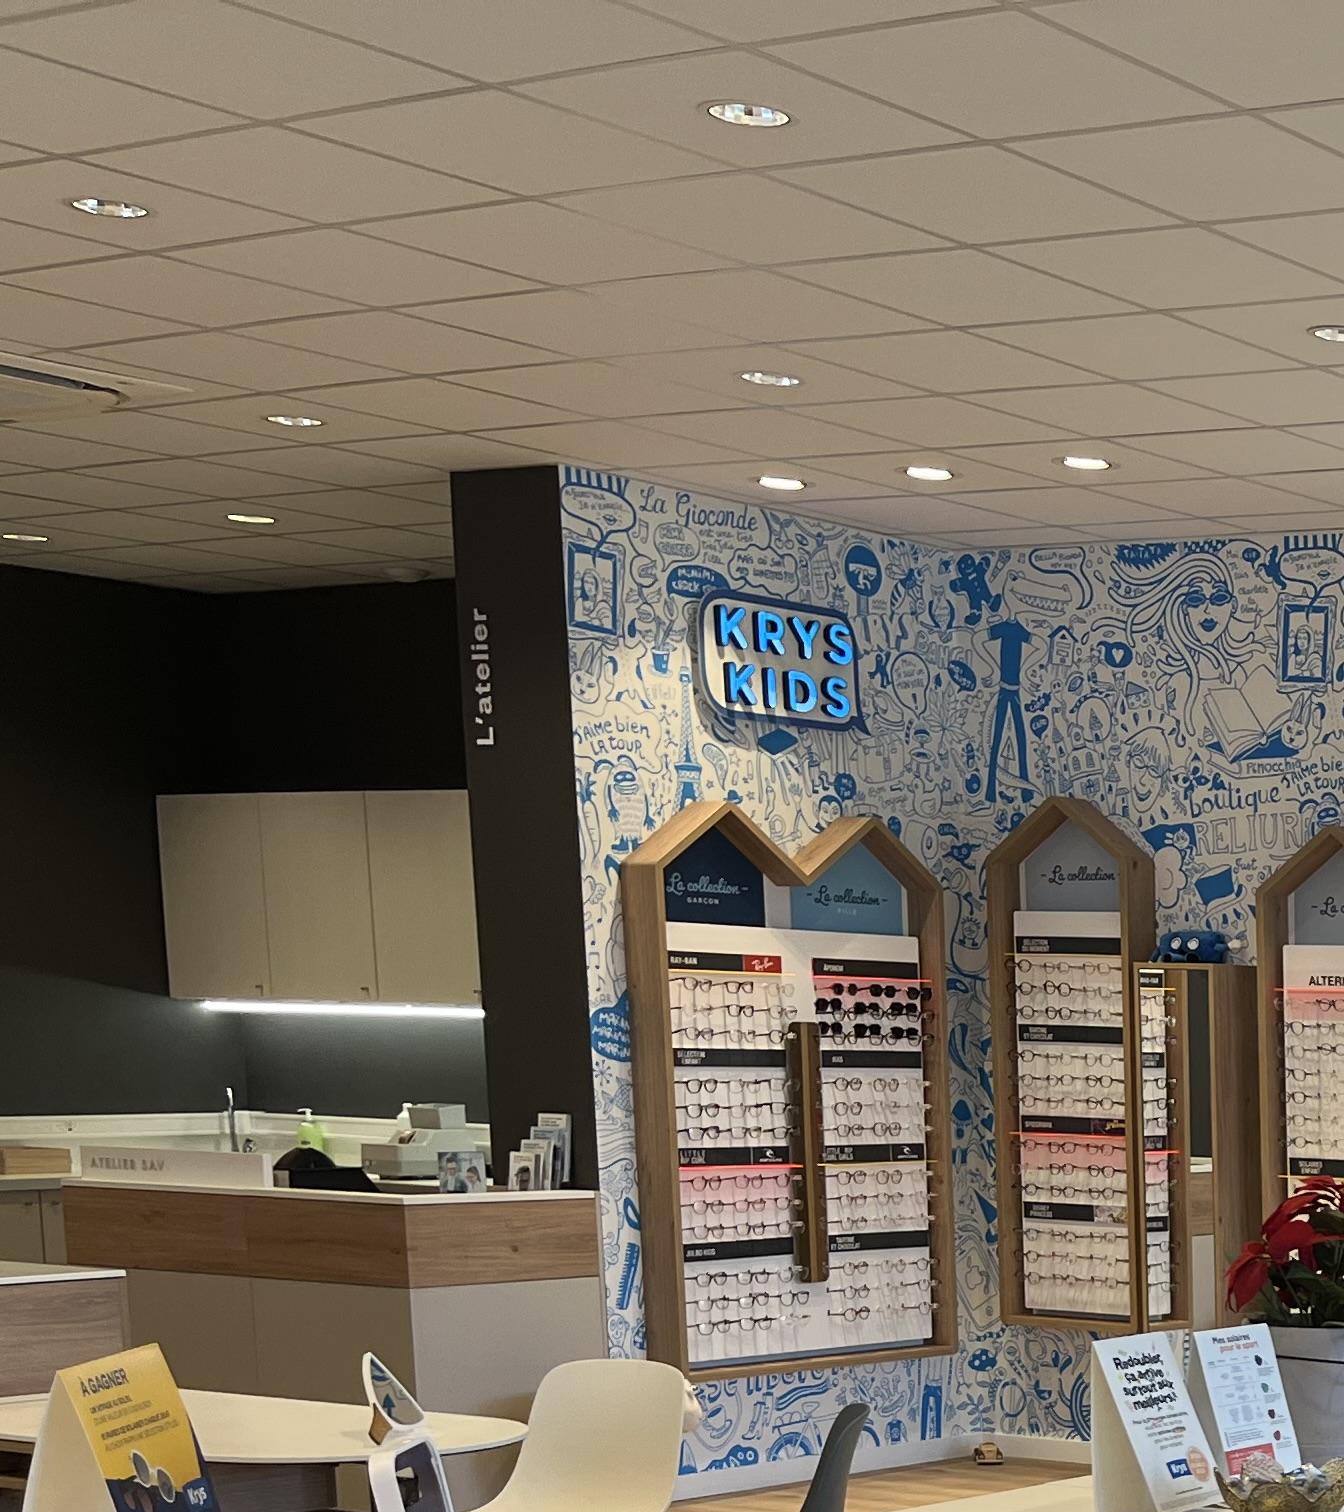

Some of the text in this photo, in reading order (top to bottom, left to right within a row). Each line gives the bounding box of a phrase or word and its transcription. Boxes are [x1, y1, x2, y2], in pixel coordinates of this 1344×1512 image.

[639, 486, 668, 515] La
[675, 491, 759, 531] Gioconde
[714, 603, 854, 666] KRYS
[470, 608, 495, 746] L'atelier
[724, 661, 851, 719] KIDS
[614, 715, 651, 739] bien
[1189, 785, 1282, 818] boutique
[666, 872, 740, 896] La collection
[1048, 864, 1116, 886] La collection
[813, 885, 882, 907] La collection
[1319, 896, 1338, 918] La
[670, 956, 698, 965] RAY-BAN
[90, 1157, 136, 1170] ATELIER
[87, 1367, 130, 1394] GAGNER
